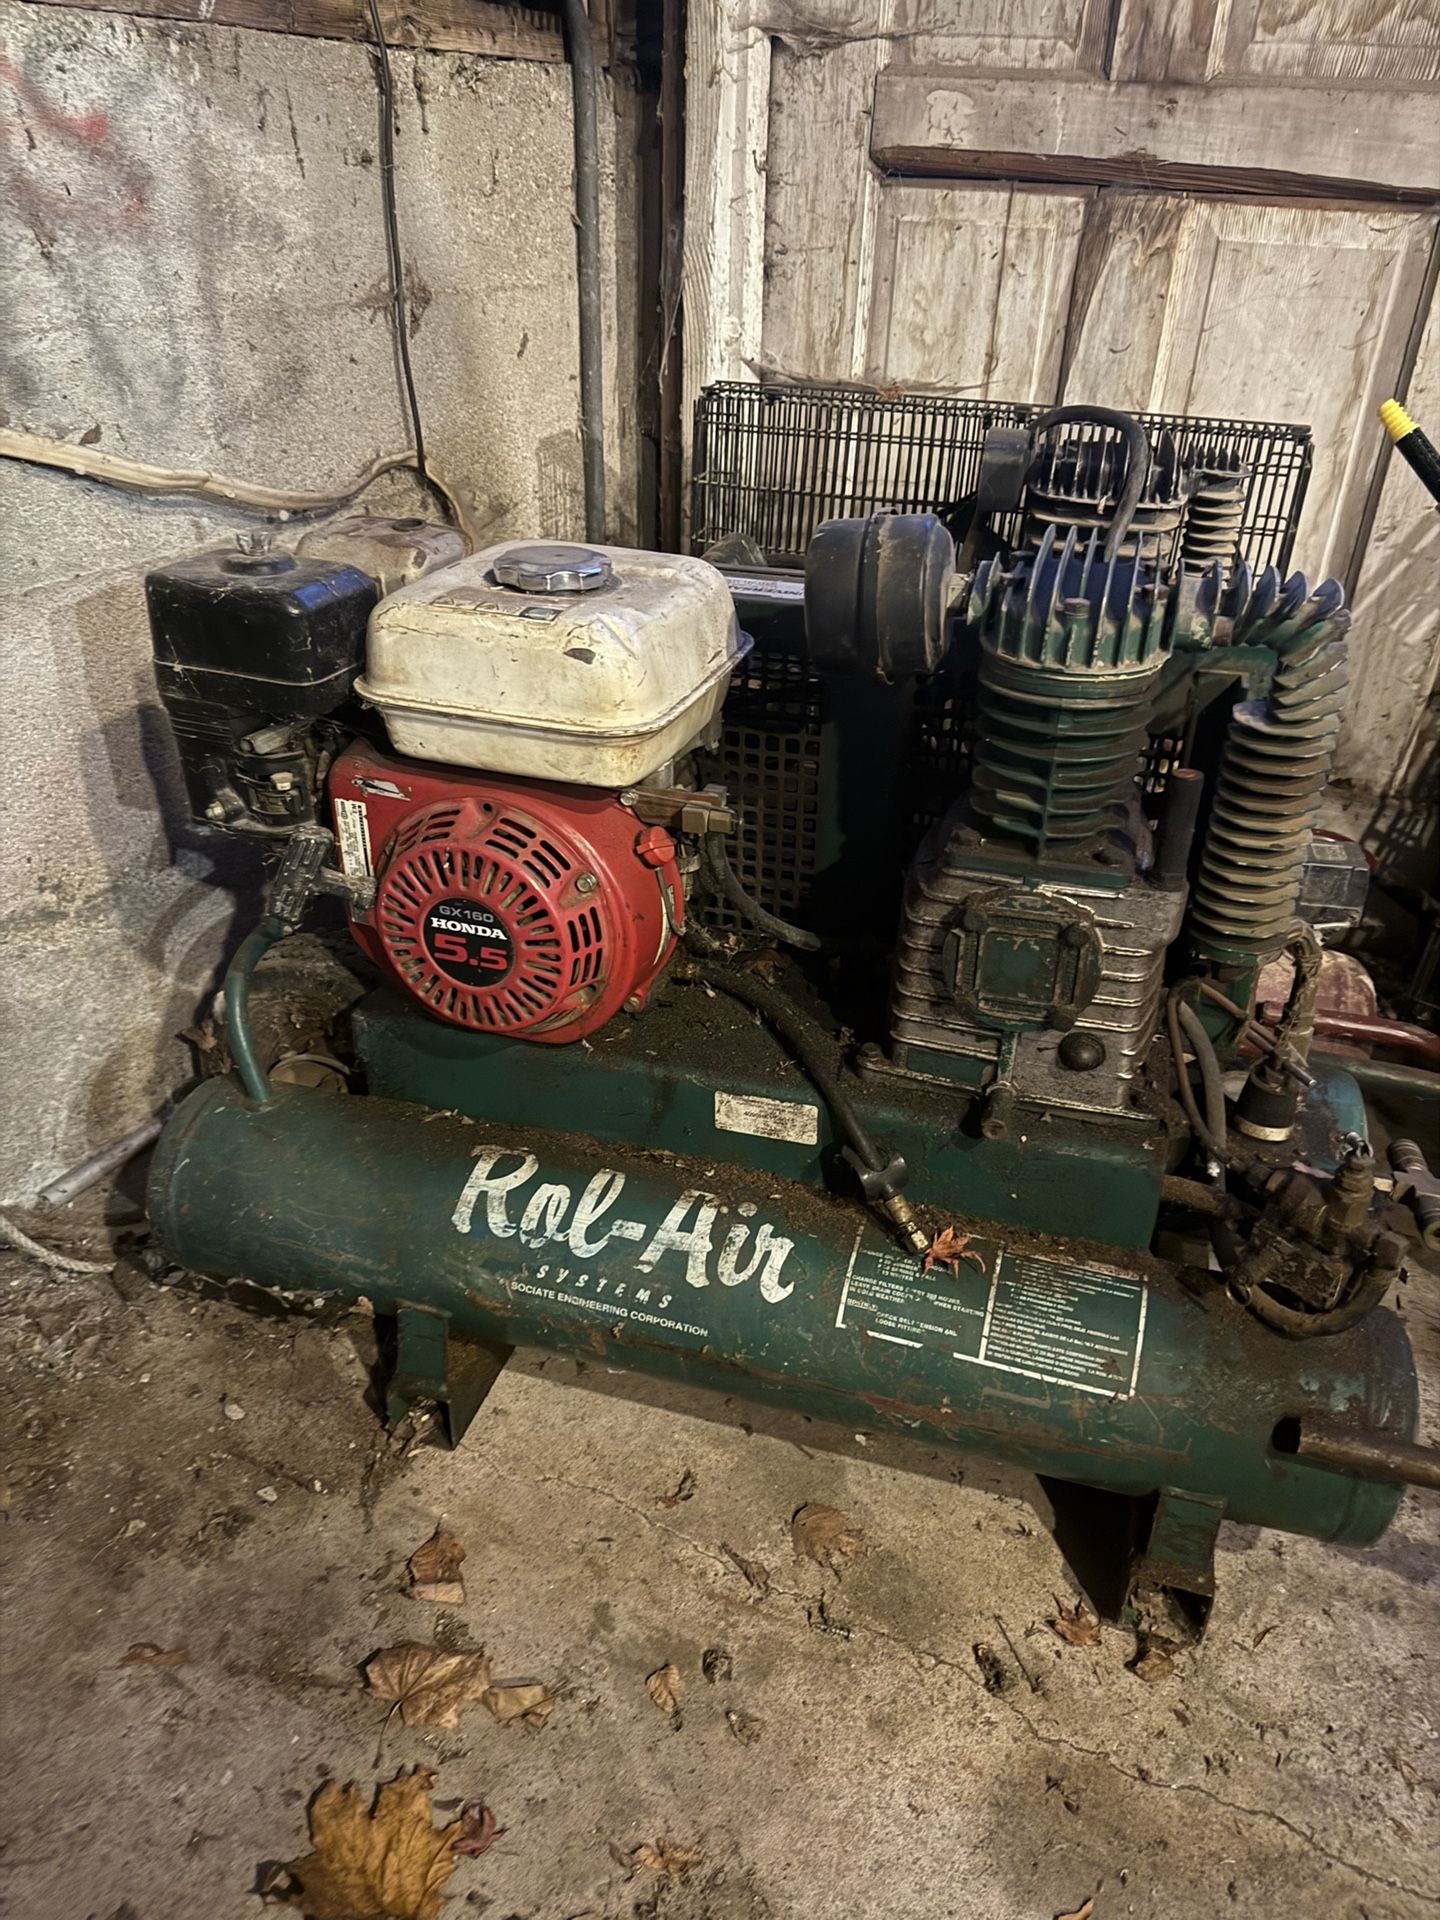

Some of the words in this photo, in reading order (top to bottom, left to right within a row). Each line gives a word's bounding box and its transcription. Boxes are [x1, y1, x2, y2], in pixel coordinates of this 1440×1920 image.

[430, 916, 508, 941] HONDA
[439, 905, 495, 923] GX160
[434, 932, 508, 971] 5.5
[451, 1144, 796, 1304] Rol-Air
[536, 1264, 673, 1310] SYSTEMS
[871, 1285, 891, 1294] DRAIN
[878, 1281, 904, 1291] FILTERS
[509, 1280, 555, 1299] SOCIATE
[556, 1291, 629, 1318] ENGINEERING
[630, 1310, 710, 1338] CORPORATION
